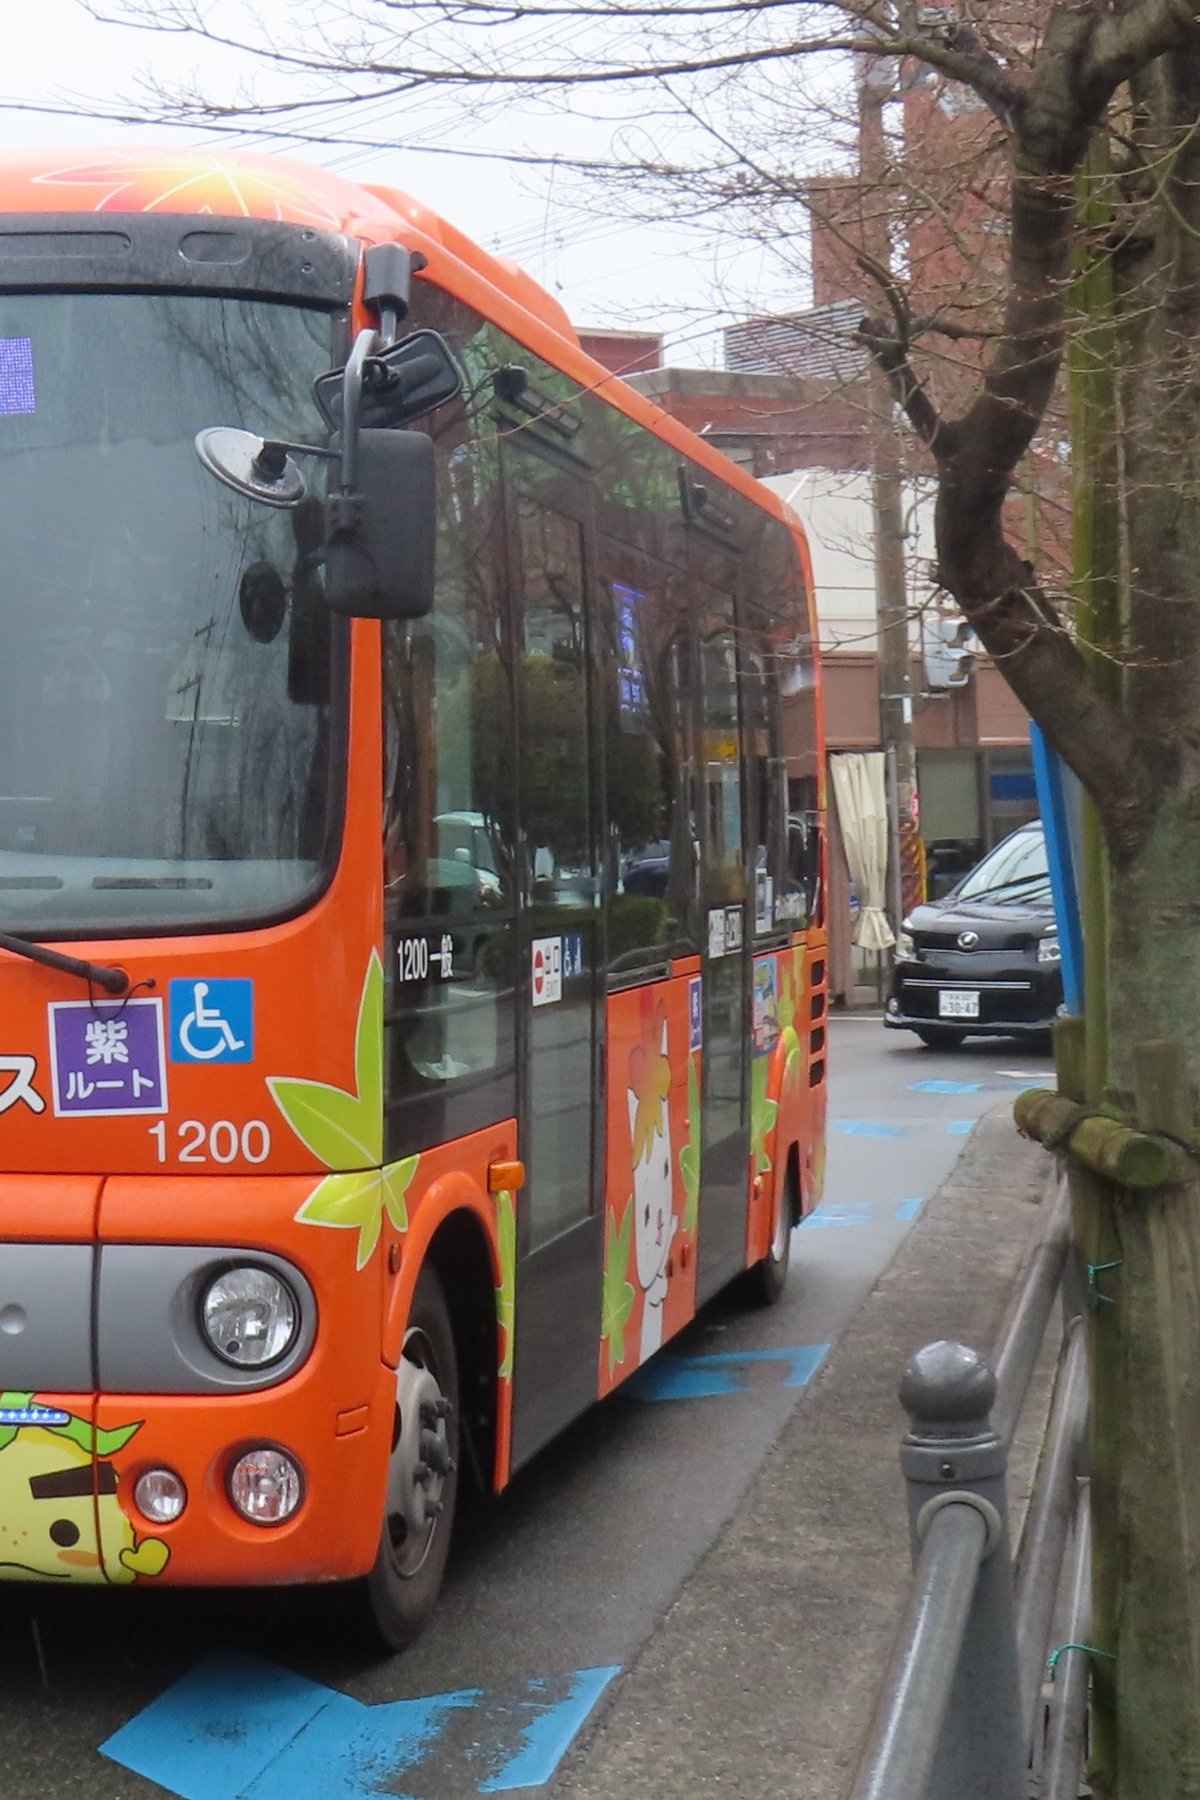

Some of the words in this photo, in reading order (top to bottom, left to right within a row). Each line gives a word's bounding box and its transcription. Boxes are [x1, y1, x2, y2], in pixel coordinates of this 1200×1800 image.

[84, 1019, 130, 1066] 紫
[65, 1068, 155, 1101] ルート
[147, 1119, 272, 1164] 1200
